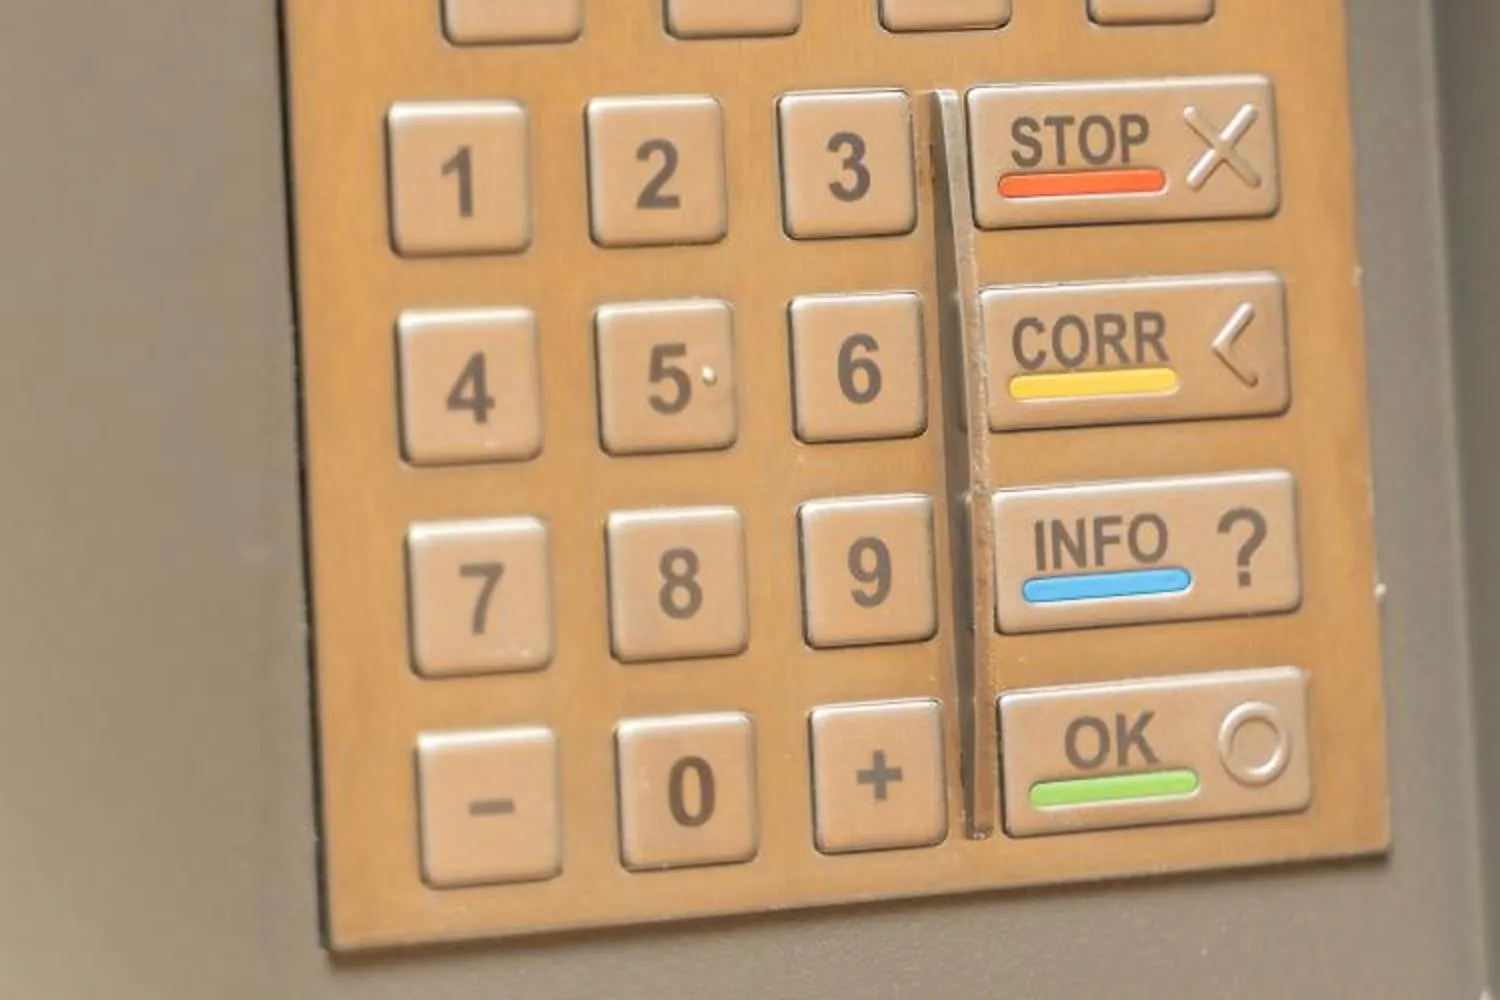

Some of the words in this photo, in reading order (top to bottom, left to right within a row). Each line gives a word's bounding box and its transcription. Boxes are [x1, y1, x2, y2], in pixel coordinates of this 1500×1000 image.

[635, 140, 681, 210] 2
[828, 132, 870, 201] 3
[1011, 115, 1150, 167] STOP
[441, 146, 475, 217] 1
[838, 335, 882, 403] 6
[1012, 311, 1169, 369] CORR
[448, 353, 495, 424] 4
[650, 344, 691, 414] 5
[659, 548, 702, 618] 8
[848, 537, 891, 606] 9
[1034, 514, 1168, 573] INFO
[1217, 509, 1266, 587] ?
[460, 562, 503, 634] 7
[856, 750, 902, 801] +
[1064, 712, 1157, 770] OK
[668, 756, 715, 827] 0
